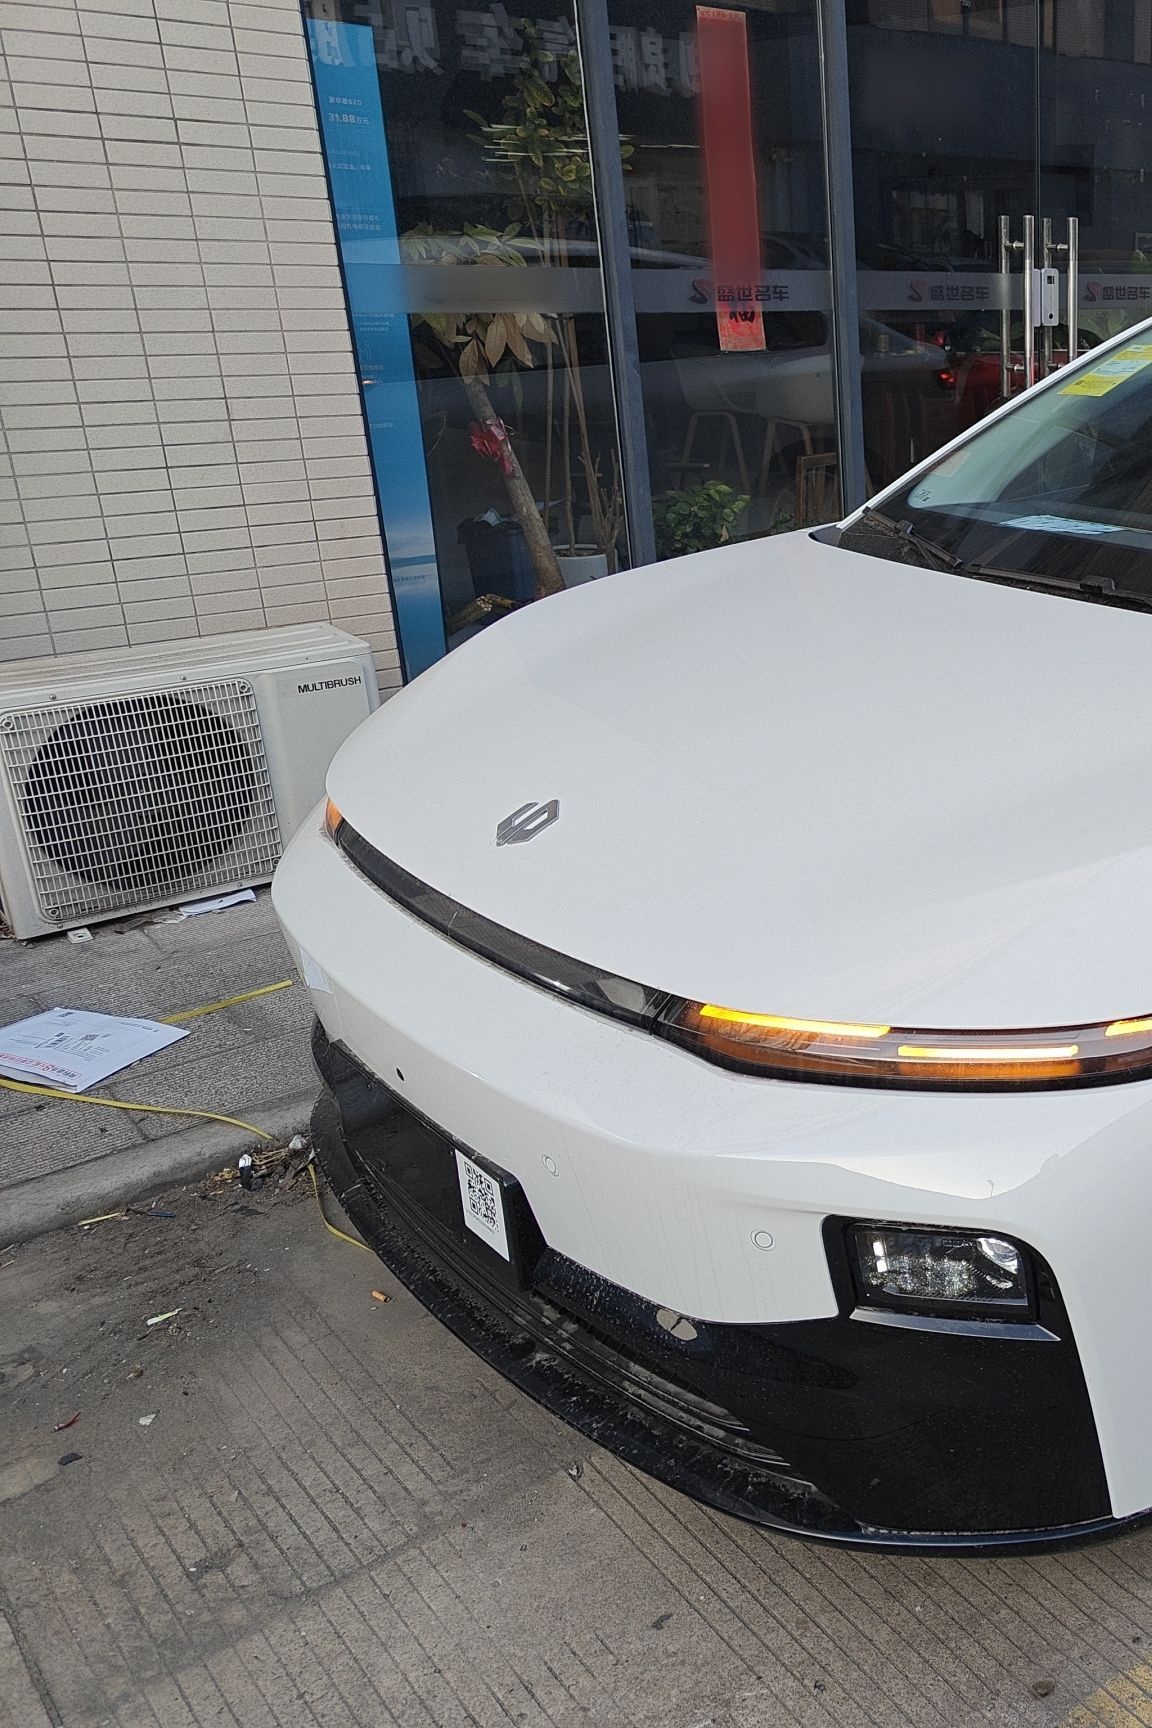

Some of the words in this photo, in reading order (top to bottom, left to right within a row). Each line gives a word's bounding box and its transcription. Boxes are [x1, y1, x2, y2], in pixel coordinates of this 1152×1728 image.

[717, 284, 789, 302] 盛世名车
[930, 285, 990, 301] 盛世名车
[1102, 285, 1152, 301] 盛世名车
[297, 676, 362, 694] MULTIBRUSH
